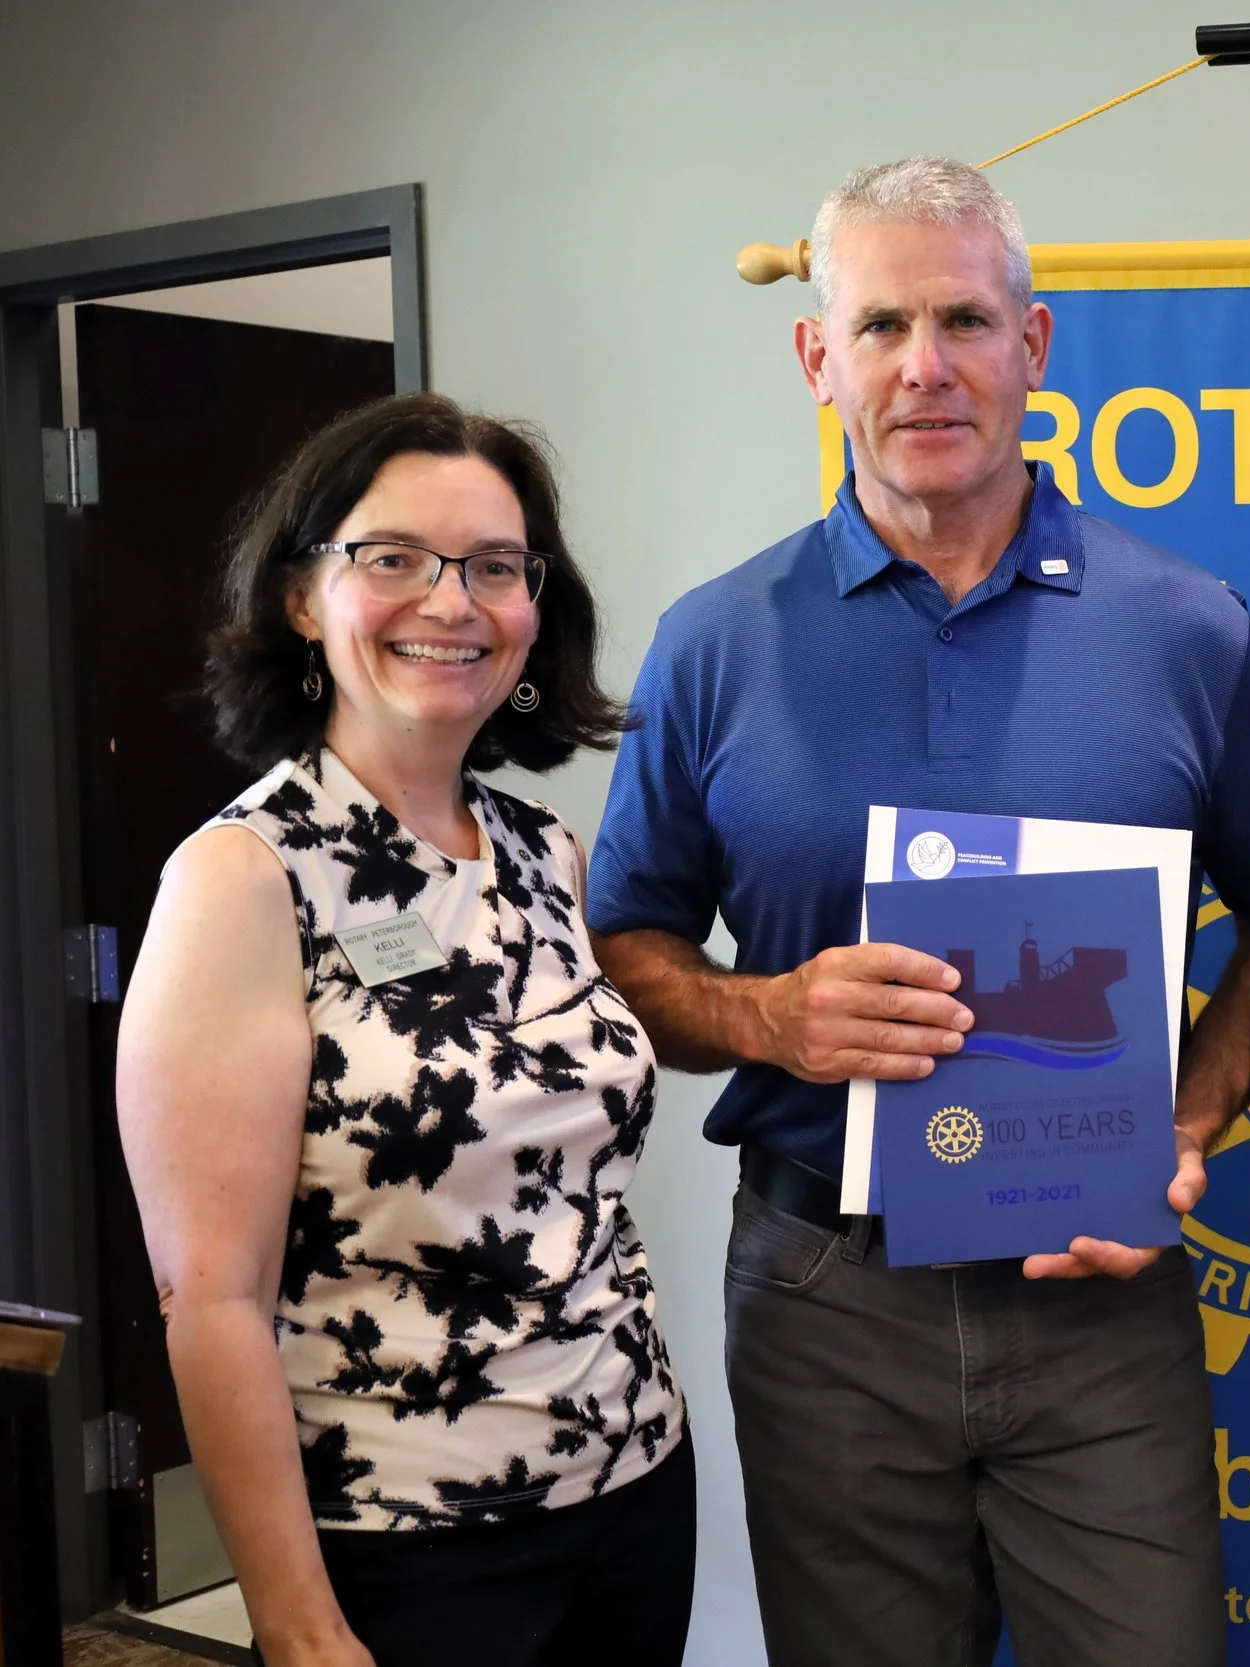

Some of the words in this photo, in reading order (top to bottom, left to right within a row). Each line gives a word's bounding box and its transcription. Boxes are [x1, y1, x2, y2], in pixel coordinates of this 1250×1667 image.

[957, 852, 991, 860] PEACEBUILDING
[344, 933, 367, 945] ROTARY
[372, 921, 417, 937] PETERBOROUGH
[374, 937, 405, 952] KELLI
[377, 956, 392, 966] KELLI
[387, 960, 416, 972] DIRECTOR
[986, 1118, 1025, 1144] 100
[1037, 1109, 1136, 1140] YEARS
[982, 1146, 1045, 1161] INVESTING
[1063, 1140, 1136, 1156] COMMUNITY
[986, 1184, 1081, 1205] 1921-2021
